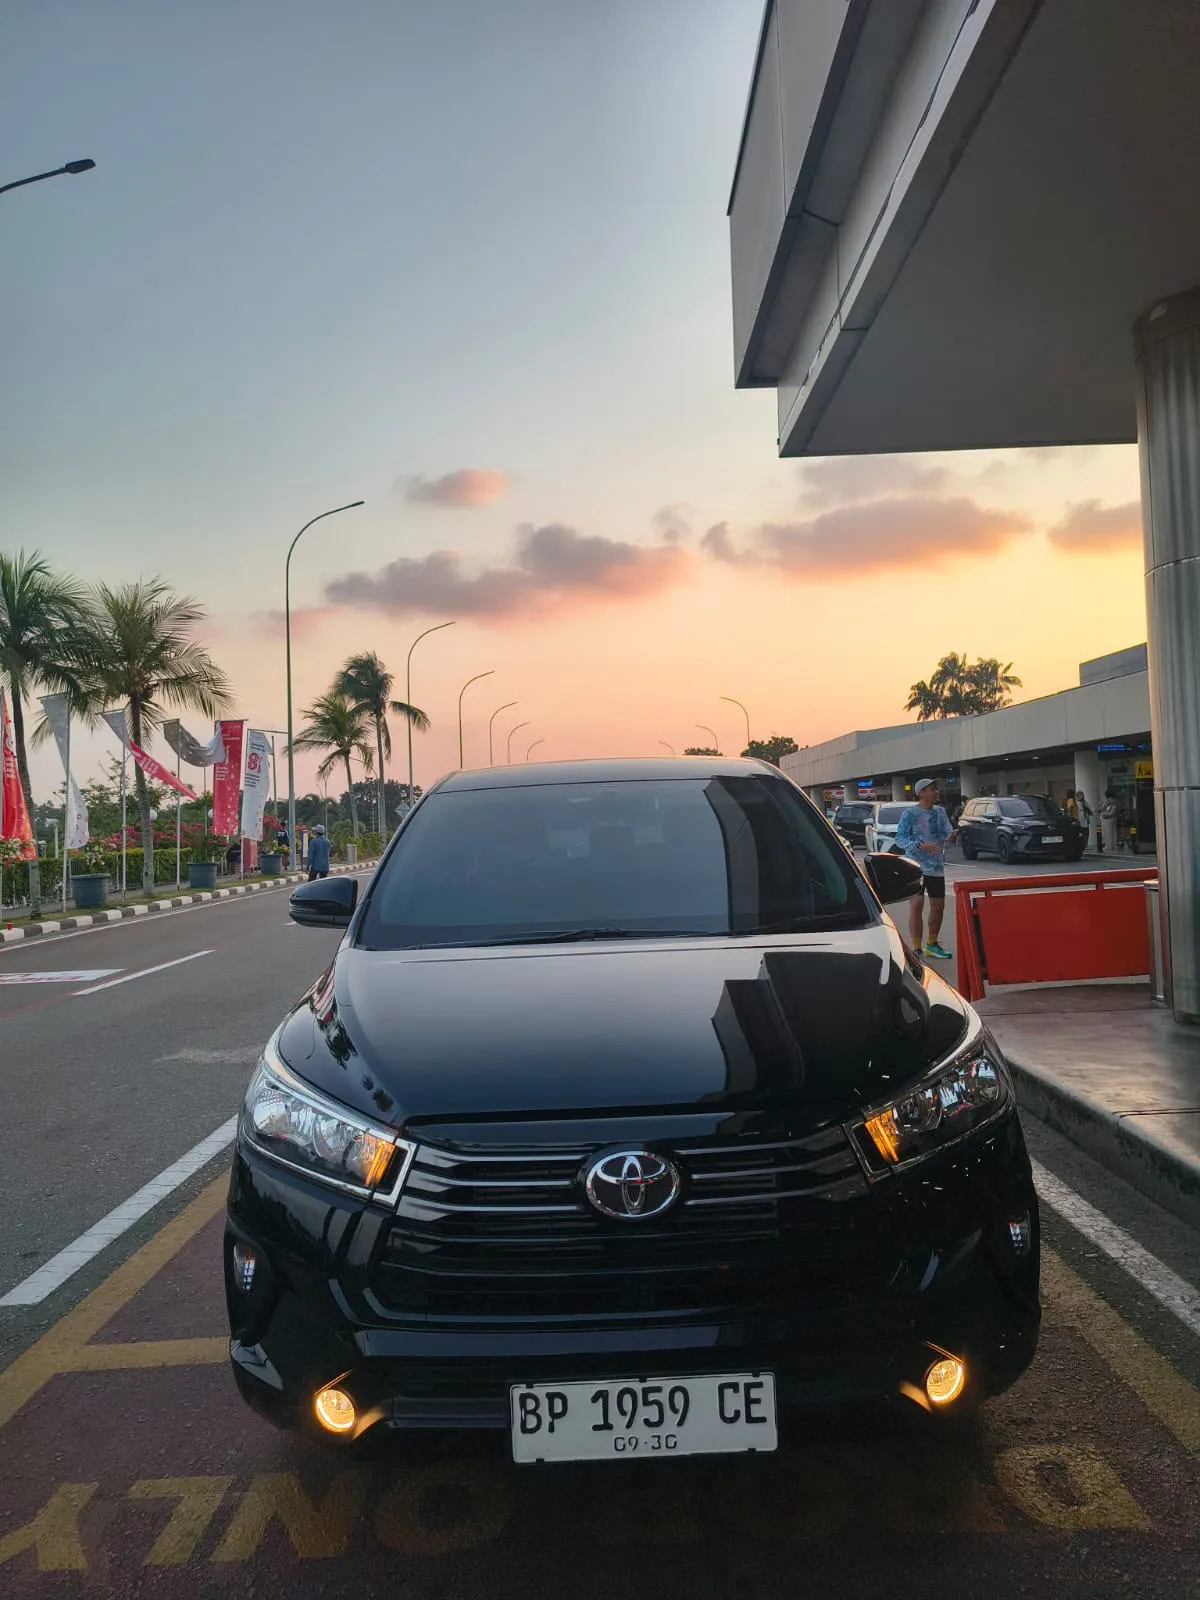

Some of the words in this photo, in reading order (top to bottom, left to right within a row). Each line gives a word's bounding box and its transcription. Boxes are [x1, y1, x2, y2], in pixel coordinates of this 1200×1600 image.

[519, 1392, 568, 1434] BP
[590, 1385, 690, 1432] 1959
[718, 1381, 767, 1424] CE
[0, 1465, 514, 1572] ONLY
